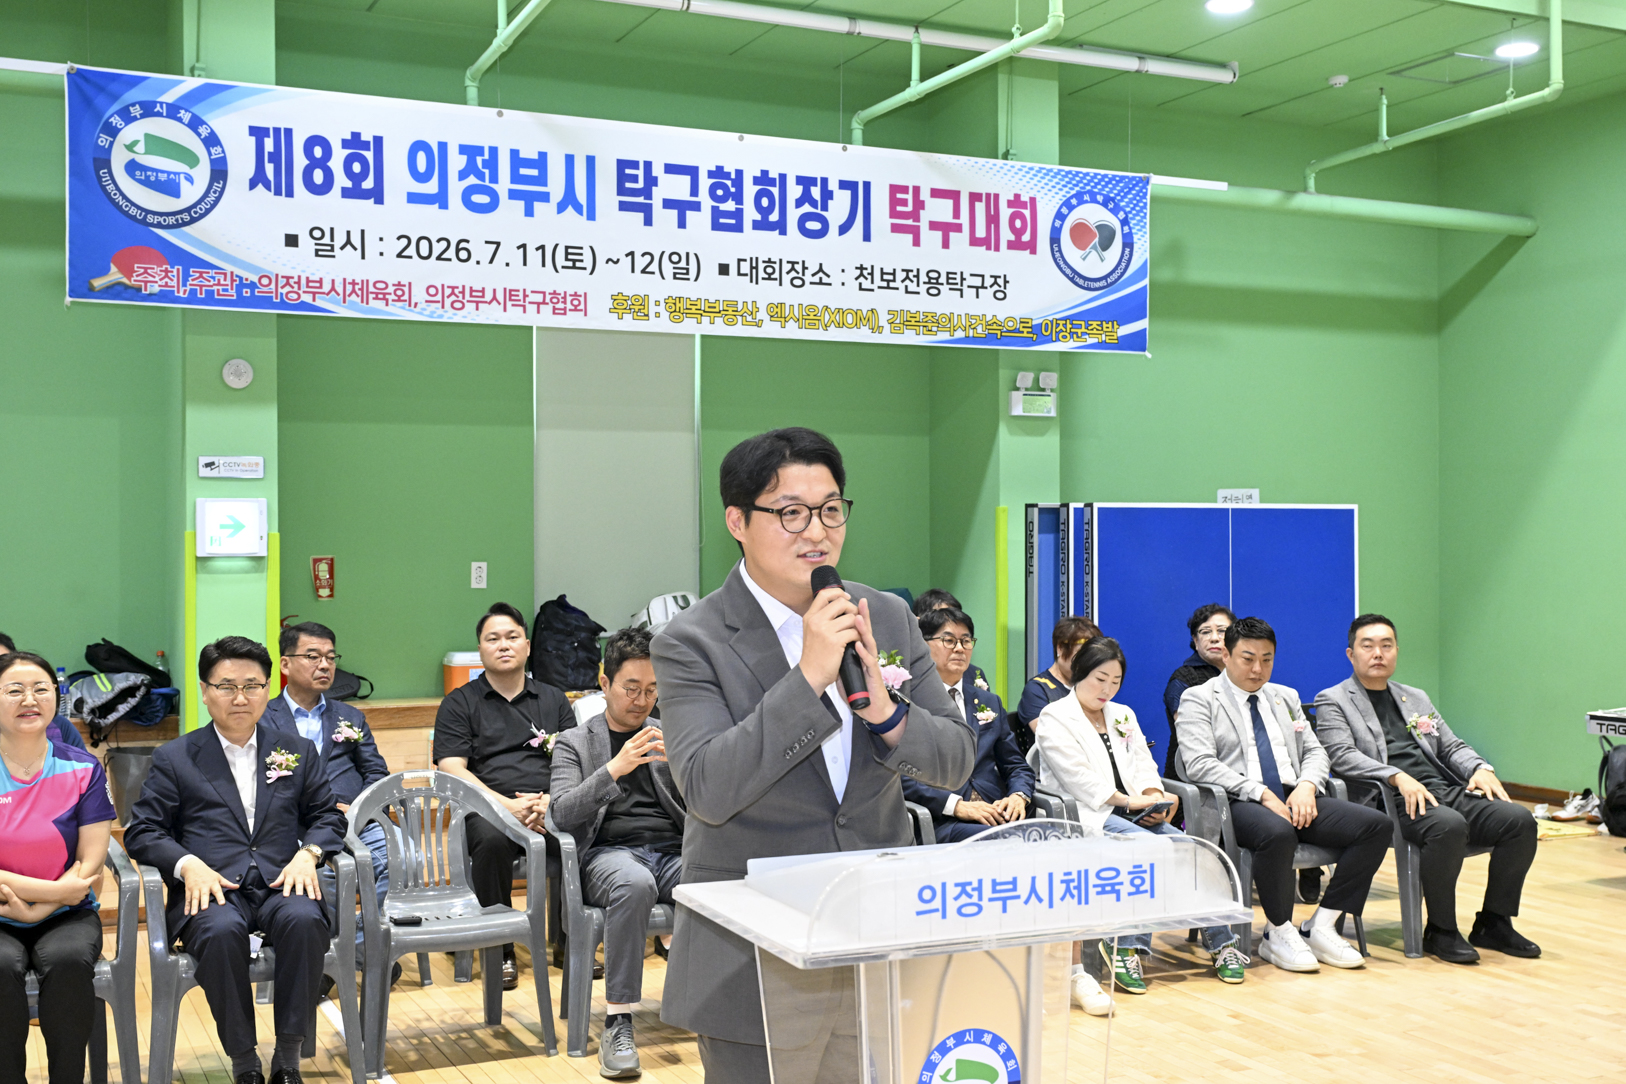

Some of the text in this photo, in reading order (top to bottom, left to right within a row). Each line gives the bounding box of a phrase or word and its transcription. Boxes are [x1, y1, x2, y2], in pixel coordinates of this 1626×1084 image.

[98, 103, 224, 158] 의정부시체육회
[99, 168, 223, 225] UIJEONGBU SPORTS COUNCIL
[135, 170, 179, 182] 의정부시
[248, 125, 1038, 256] 제8회 의정부시 탁구협회장기 탁구대회
[131, 264, 239, 299] 주최,주관
[254, 272, 418, 309] 의정부시체육회,
[424, 283, 588, 318] 의정부시탁구협회
[308, 226, 367, 261] 일시
[395, 233, 598, 276] 2026.7.11(토)
[735, 255, 833, 292] 대회장소
[854, 263, 1010, 302] 천보전용탁구장
[609, 292, 650, 322] 후원
[664, 296, 764, 329] 행복부동산,
[1041, 318, 1120, 345] 이장군족발
[914, 862, 1156, 919] 의정부시체육회
[921, 1030, 1017, 1083] 의정부시체육회
